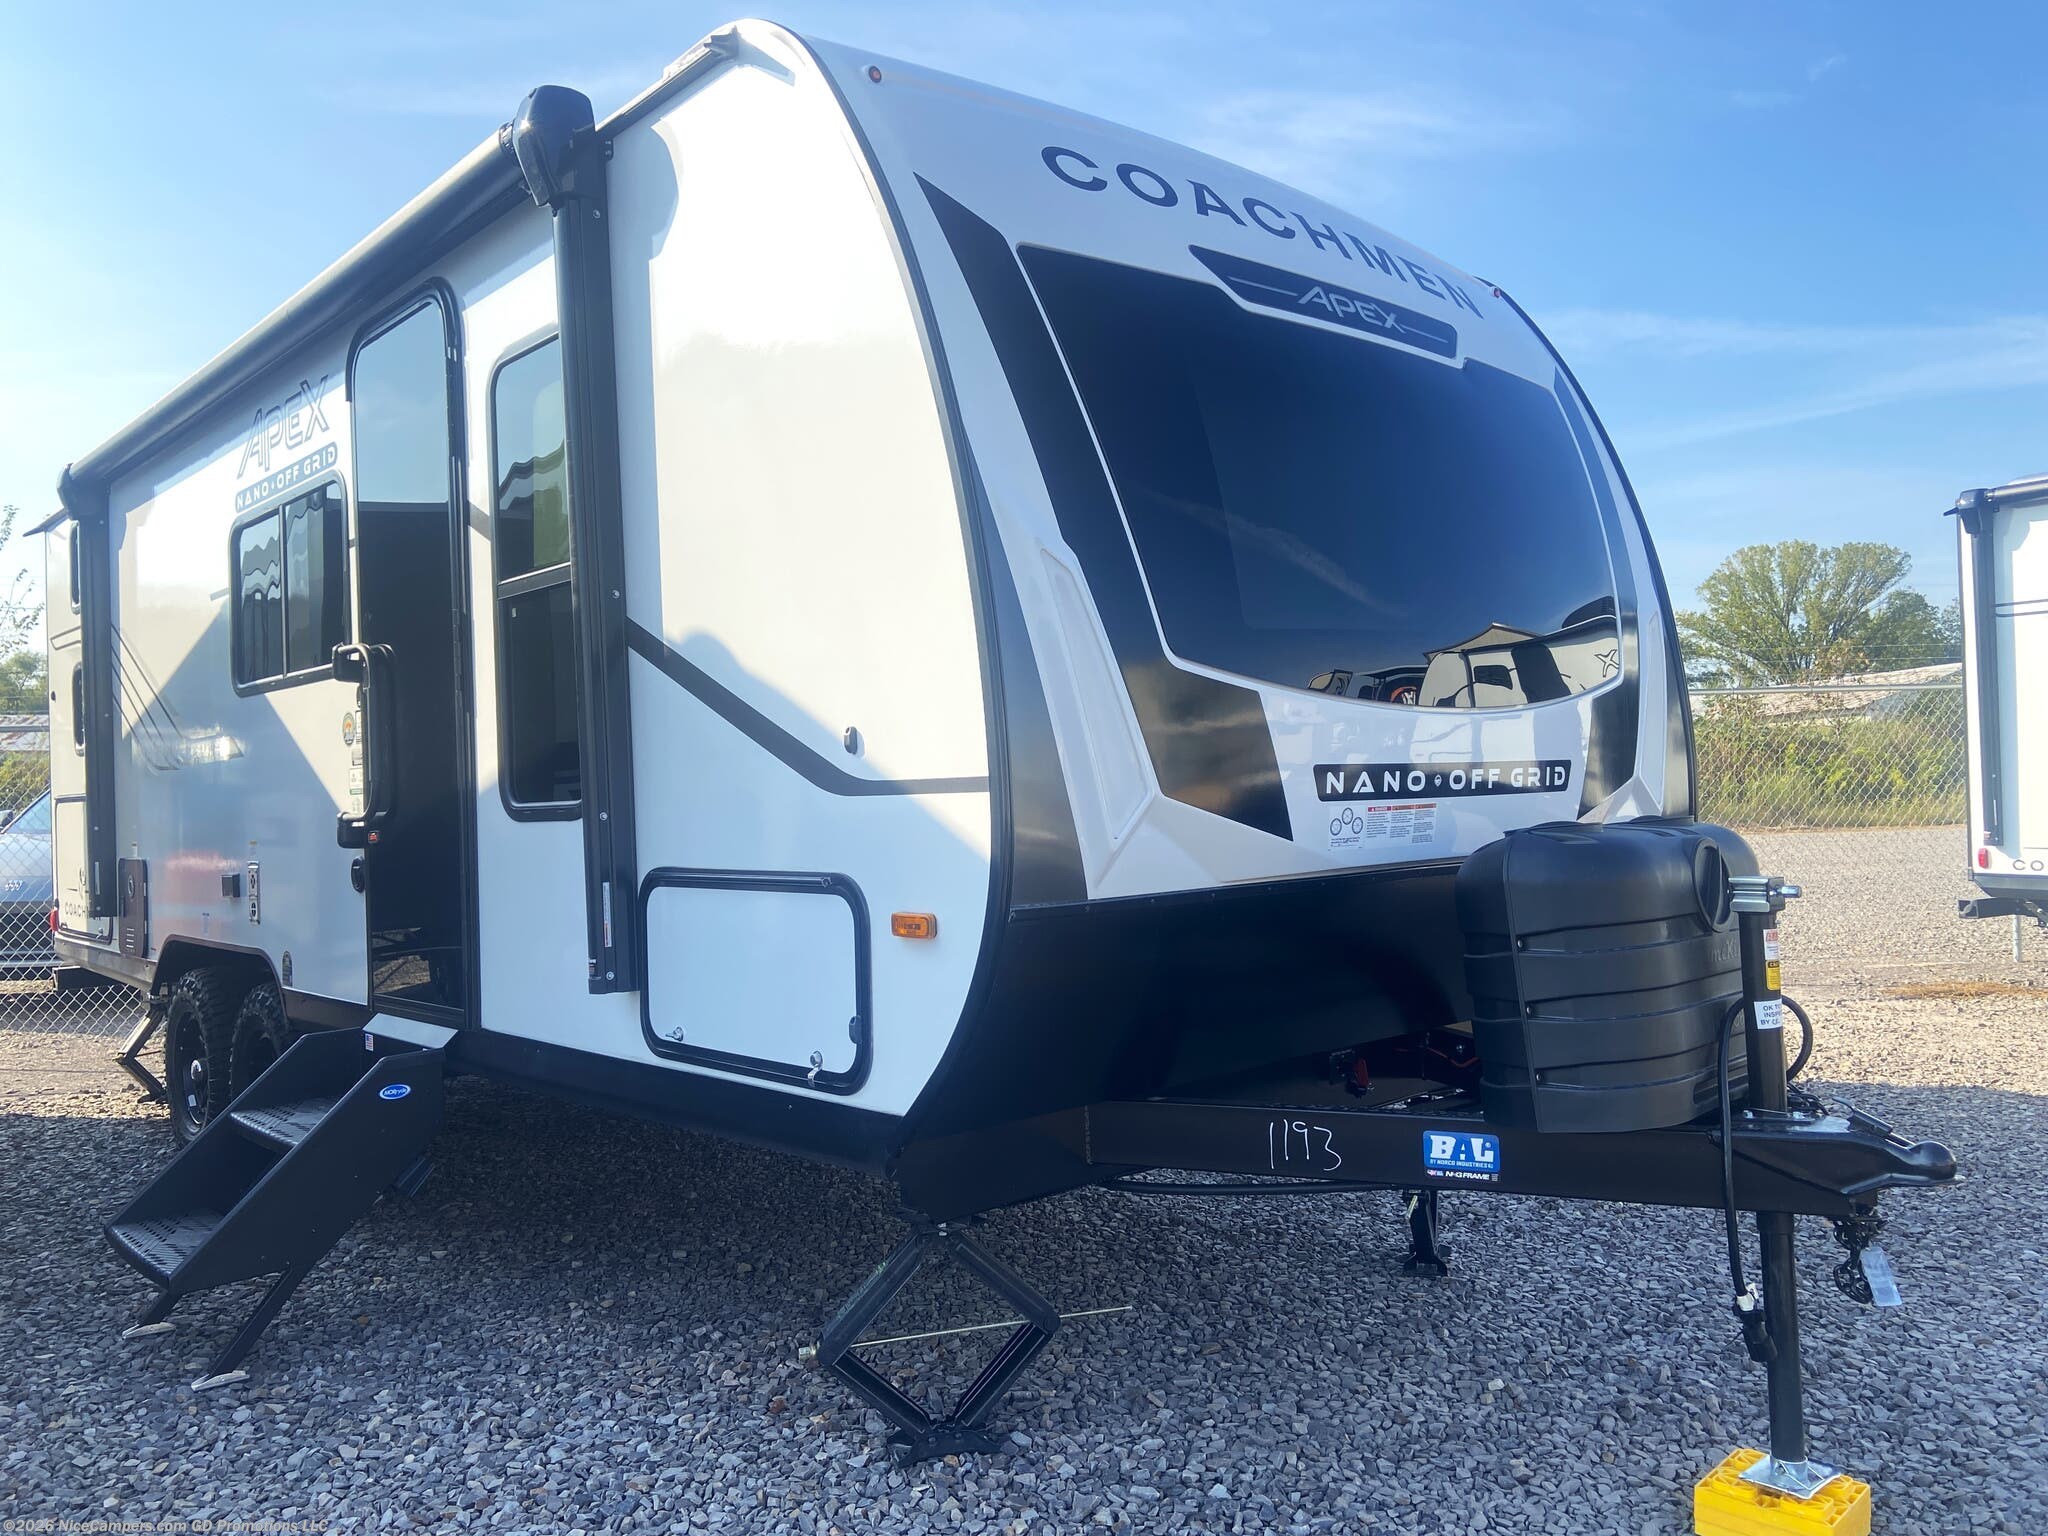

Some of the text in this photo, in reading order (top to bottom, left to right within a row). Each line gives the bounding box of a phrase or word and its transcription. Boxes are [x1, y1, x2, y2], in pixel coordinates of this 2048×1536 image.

[1041, 146, 1484, 319] COACHMEN
[1298, 284, 1405, 334] APEX
[236, 374, 330, 480] APEX
[236, 446, 336, 509] NANO OFF GRID
[1326, 766, 1567, 794] NANO OFF GRID
[1269, 1118, 1342, 1171] 1193
[1430, 1135, 1494, 1163] BAL
[1456, 1160, 1488, 1168] INDUSTRIES
[1463, 1172, 1490, 1180] FRAME
